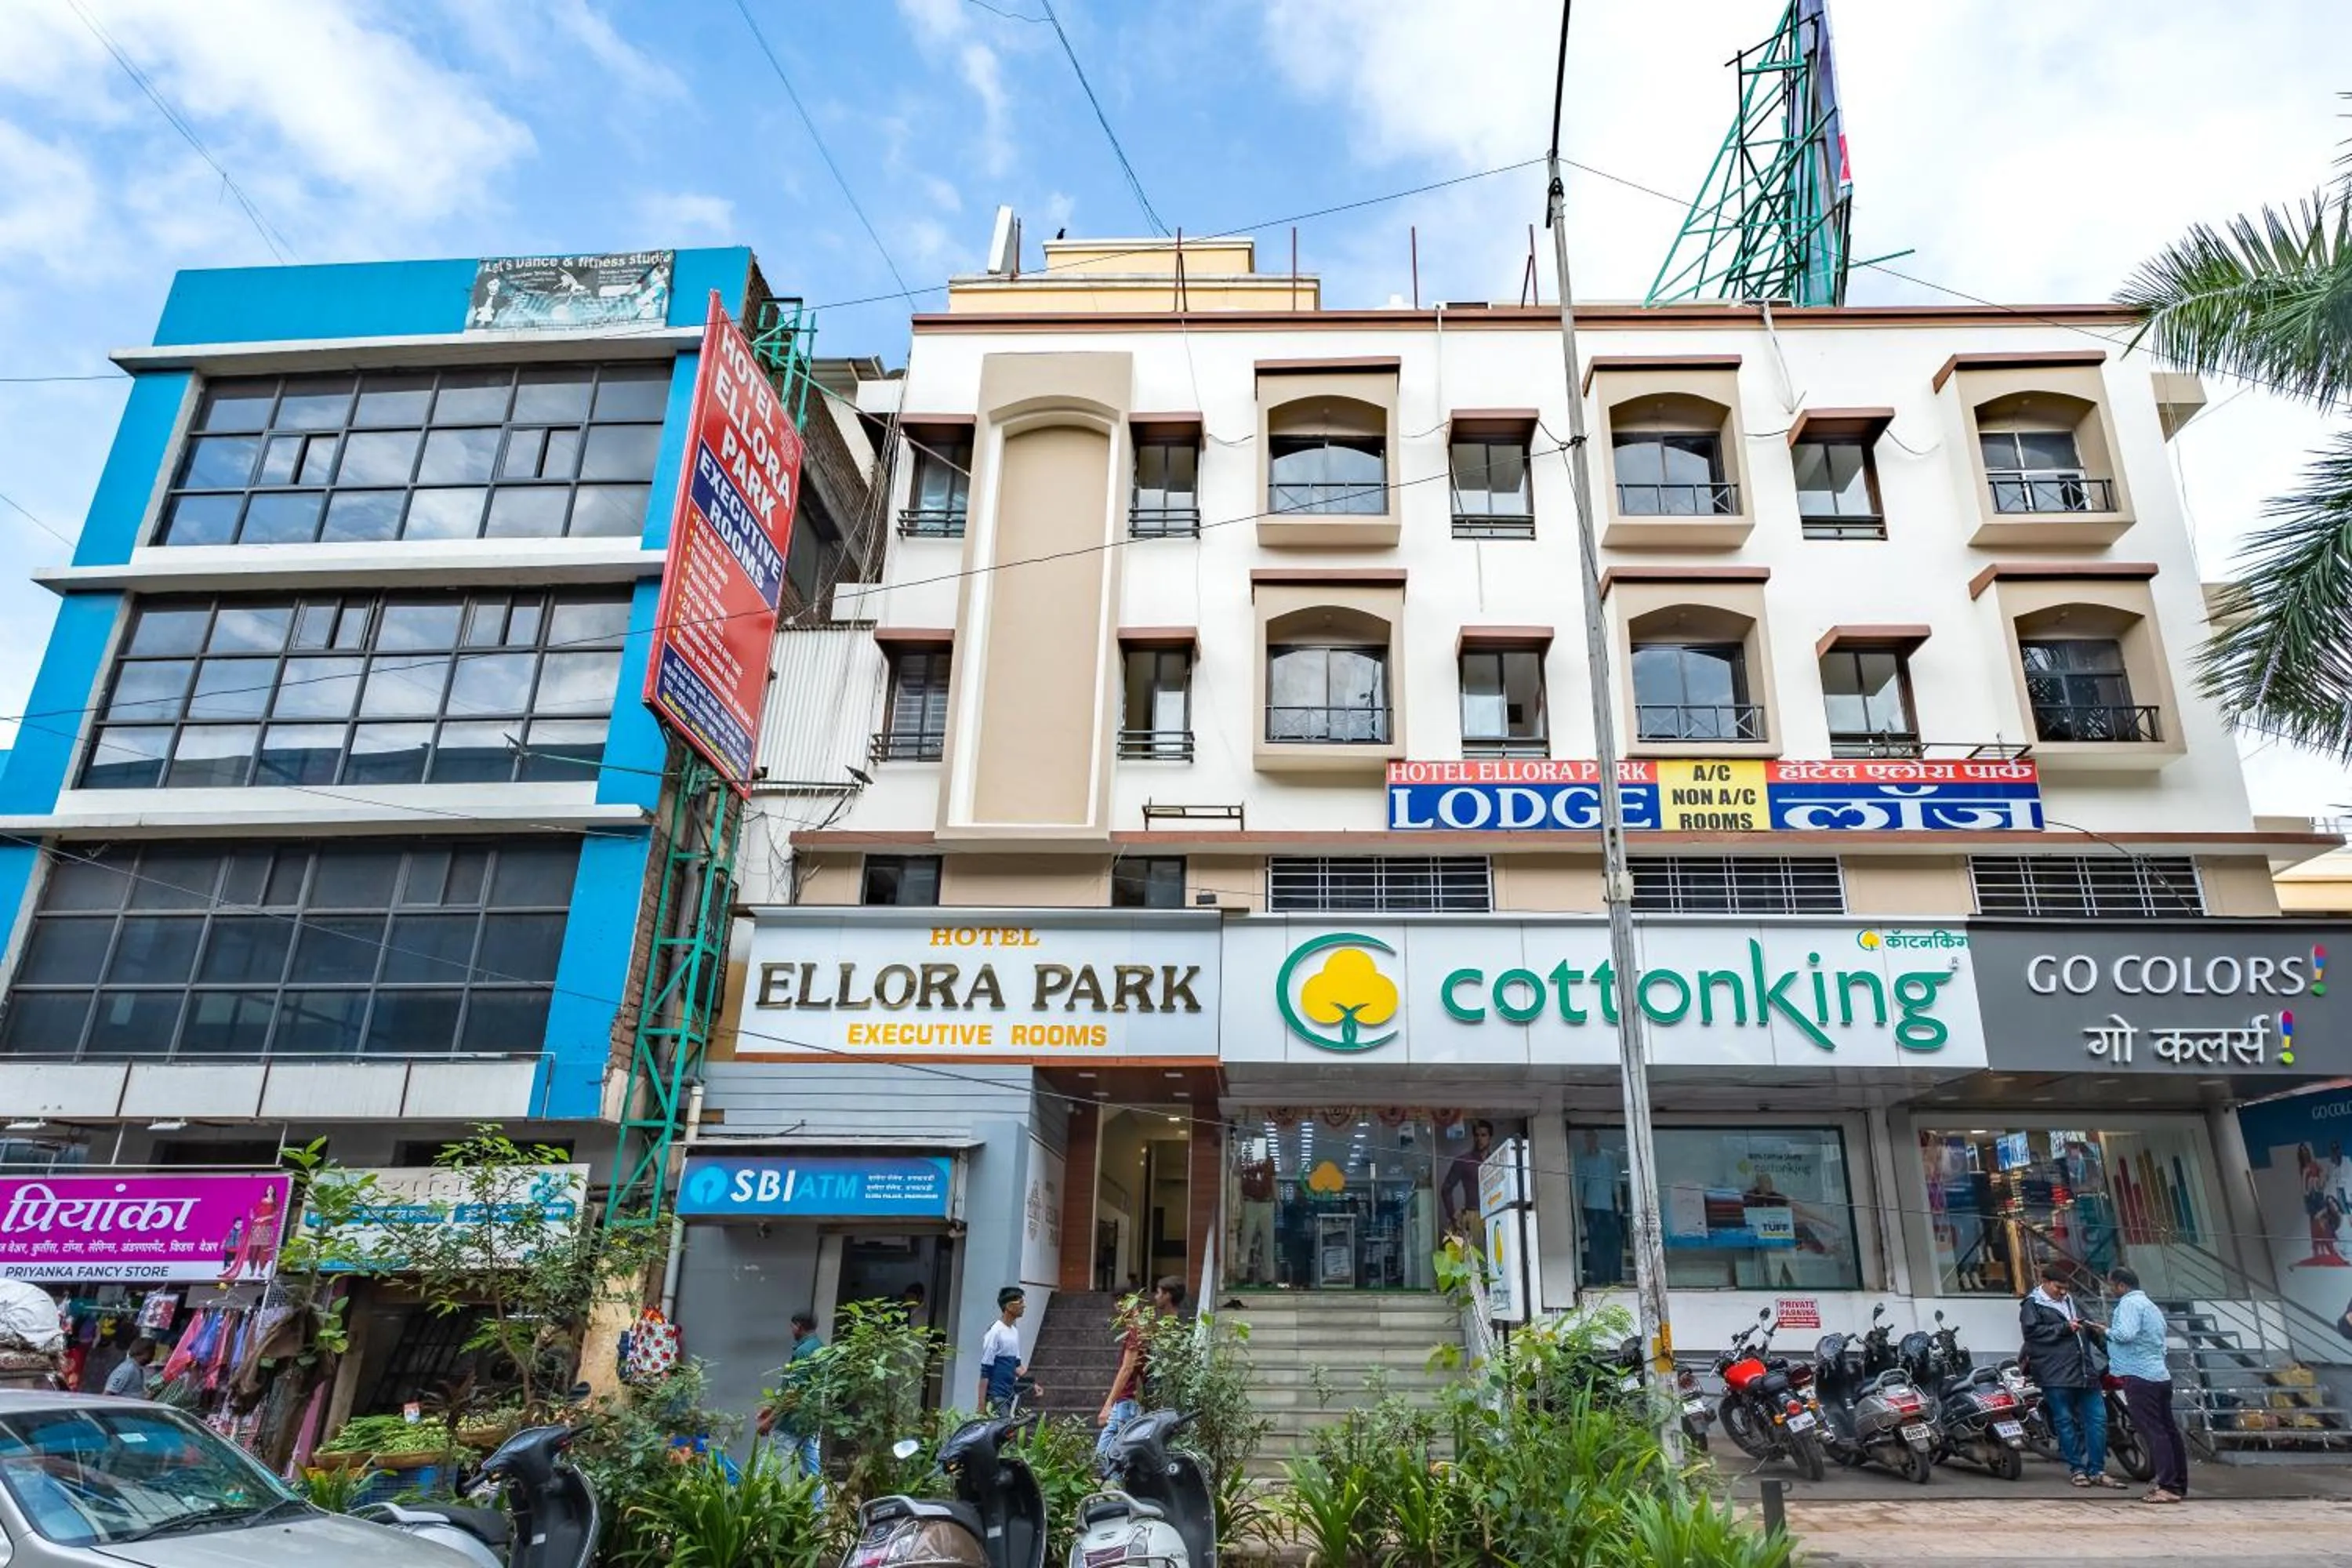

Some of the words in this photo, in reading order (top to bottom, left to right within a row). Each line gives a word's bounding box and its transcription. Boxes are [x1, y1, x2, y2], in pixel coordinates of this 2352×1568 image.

[515, 257, 557, 269] Dance
[562, 257, 573, 267] &
[721, 325, 775, 434] HOTEL
[715, 361, 790, 508] ELLORA
[720, 424, 776, 530] PARK
[699, 449, 782, 582] EXECUTIVE
[710, 498, 765, 589] ROOMS
[1390, 762, 1476, 782] HOTEL
[1479, 762, 1576, 782] ELLORA
[1581, 762, 1649, 781] PRK
[1693, 764, 1731, 782] A/C
[1864, 760, 1955, 780] एलोरा
[1962, 760, 2033, 779] पार्क
[1392, 787, 1652, 829] LODGE
[1672, 789, 1713, 806] NON
[1718, 788, 1756, 806] A/C
[1776, 785, 2042, 830] लॉज
[1679, 812, 1754, 830] ROOMS
[929, 927, 1040, 947] HOTEL
[755, 961, 1007, 1011] ELLORA
[1031, 963, 1202, 1013] PARK
[1440, 938, 1955, 1051] cottonking
[2027, 954, 2099, 994] GO
[847, 1022, 993, 1047] EXECUTIVE
[1011, 1023, 1107, 1047] ROOMS
[2082, 1014, 2139, 1063] गो
[730, 1169, 796, 1203] SBI
[1, 1182, 201, 1233] प्रियांका
[5, 1266, 74, 1278] PRIYANKA
[77, 1266, 123, 1278] FANCY
[125, 1266, 169, 1278] STORE
